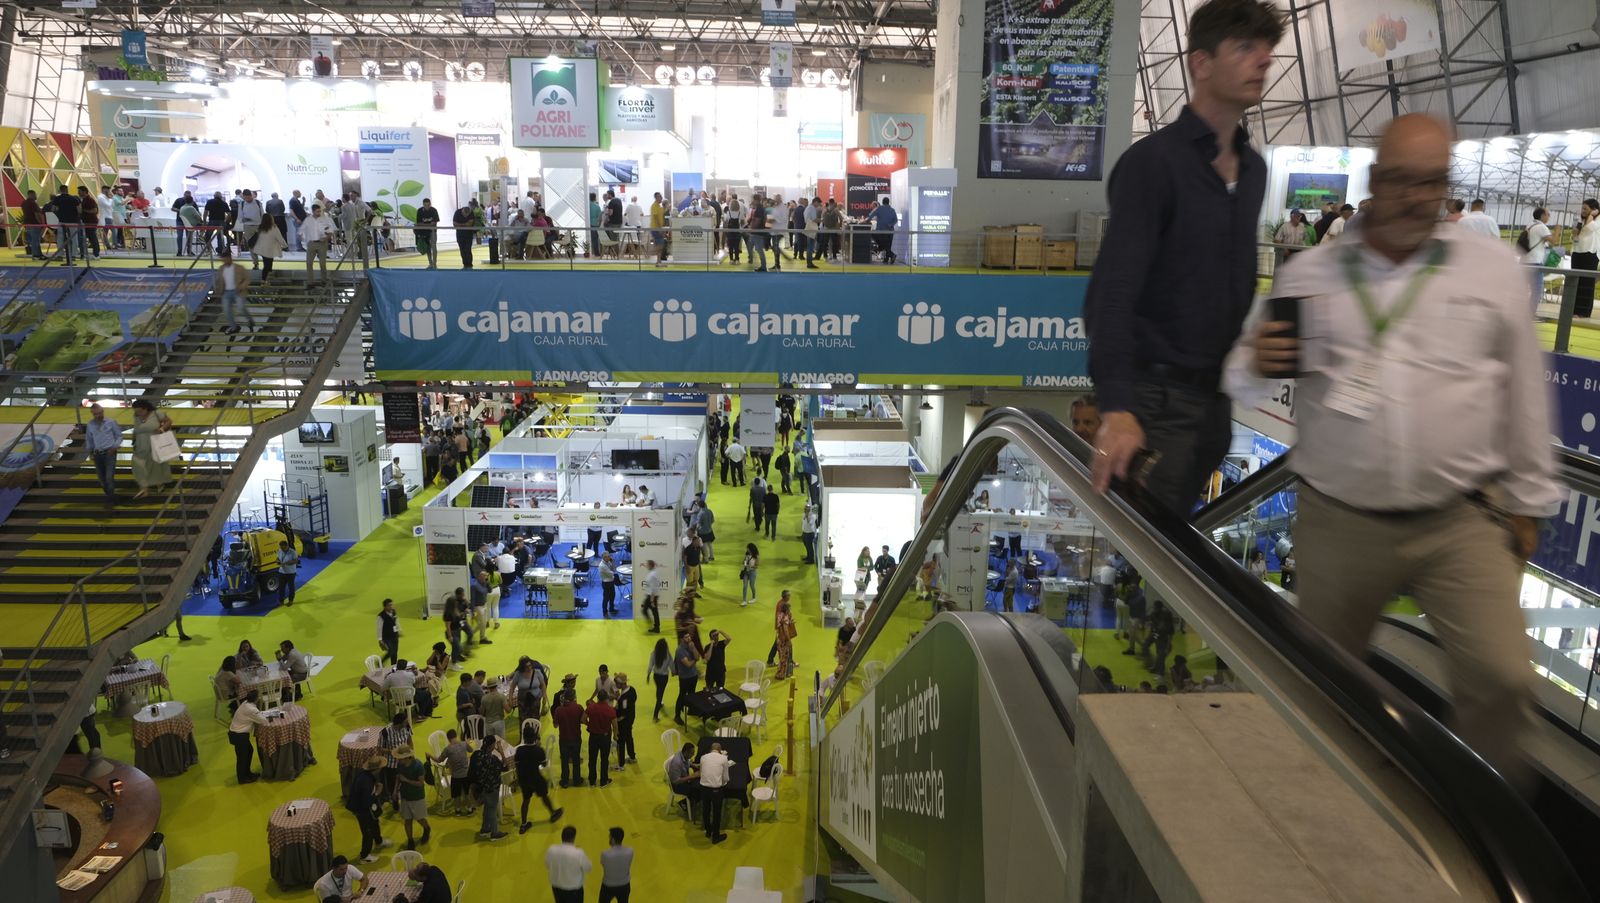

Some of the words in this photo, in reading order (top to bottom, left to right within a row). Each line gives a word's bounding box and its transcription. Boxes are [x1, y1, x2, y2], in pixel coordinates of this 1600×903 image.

[1008, 16, 1024, 24] K+S
[1050, 17, 1089, 26] nutrientes
[993, 26, 1004, 34] de
[1018, 27, 1042, 35] minas
[1043, 29, 1049, 37] y
[1049, 27, 1061, 35] los
[1062, 27, 1103, 36] transforma
[1011, 37, 1039, 45] abonos
[1040, 38, 1051, 46] de
[1052, 38, 1066, 46] alta
[1067, 38, 1096, 48] calidad
[1036, 48, 1047, 56] las
[1048, 48, 1077, 58] plantas
[1053, 64, 1094, 73] Patentkali
[996, 78, 1037, 87] Korn-Kali
[618, 99, 655, 107] FLORTAL
[535, 110, 571, 123] AGRI
[360, 131, 410, 142] Liquifert
[520, 125, 586, 138] POLYANE
[1065, 164, 1087, 172] K+S
[457, 301, 611, 343] cajamar
[707, 303, 860, 345] cajamar
[955, 306, 1088, 348] cajama
[533, 335, 565, 346] CAJA
[568, 335, 608, 346] RURAL
[782, 337, 813, 349] CAJA
[817, 337, 856, 349] RURAL
[1028, 340, 1058, 351] CAJA
[542, 370, 609, 382] ADNAGRO
[789, 372, 855, 385] ADNAGRO
[1544, 369, 1569, 385] DAS
[1584, 377, 1600, 392] BI
[880, 703, 887, 749] El
[887, 692, 907, 759] mejor
[907, 676, 941, 754] injerto
[881, 773, 894, 820] para
[894, 765, 903, 811] tu
[904, 751, 945, 820] cosecha
